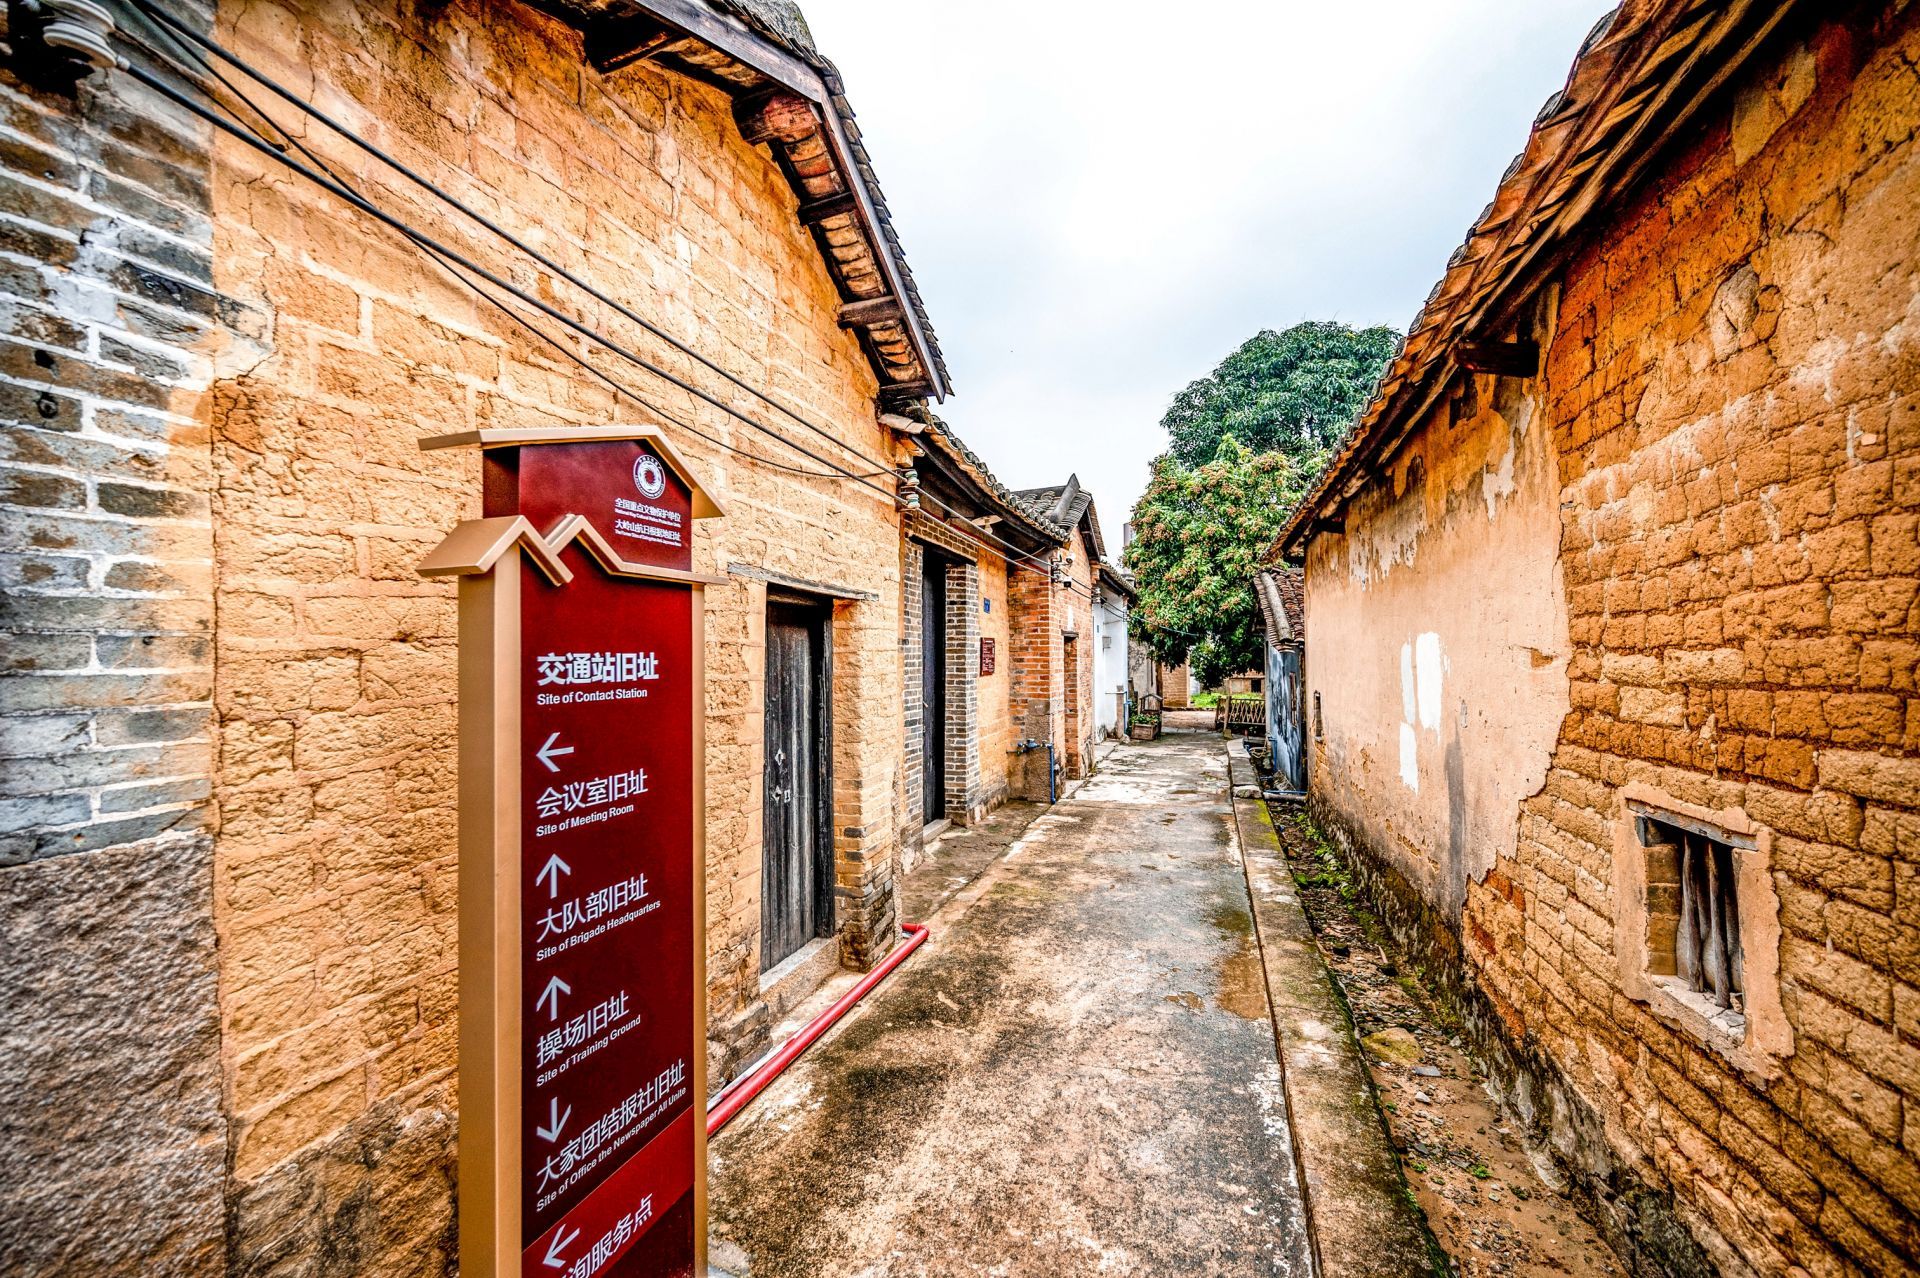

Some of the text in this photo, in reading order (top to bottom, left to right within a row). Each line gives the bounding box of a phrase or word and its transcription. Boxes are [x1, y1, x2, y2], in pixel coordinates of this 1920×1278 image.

[536, 651, 660, 686] 交通站旧址
[536, 687, 648, 706] Site of Contact Station
[536, 767, 649, 819] 会议室旧址
[536, 804, 634, 837] Site of Meeting Room
[536, 873, 649, 943] 大队部旧址
[536, 900, 661, 962] Site of Brigade Headquarters
[536, 990, 630, 1069] 操场旧址
[536, 1014, 641, 1087] Site of Training Ground
[536, 1058, 686, 1195] 大家团结报社旧址
[536, 1086, 687, 1213] Site of Office the Newspaper All Unite
[562, 1193, 653, 1278] 询服务点
